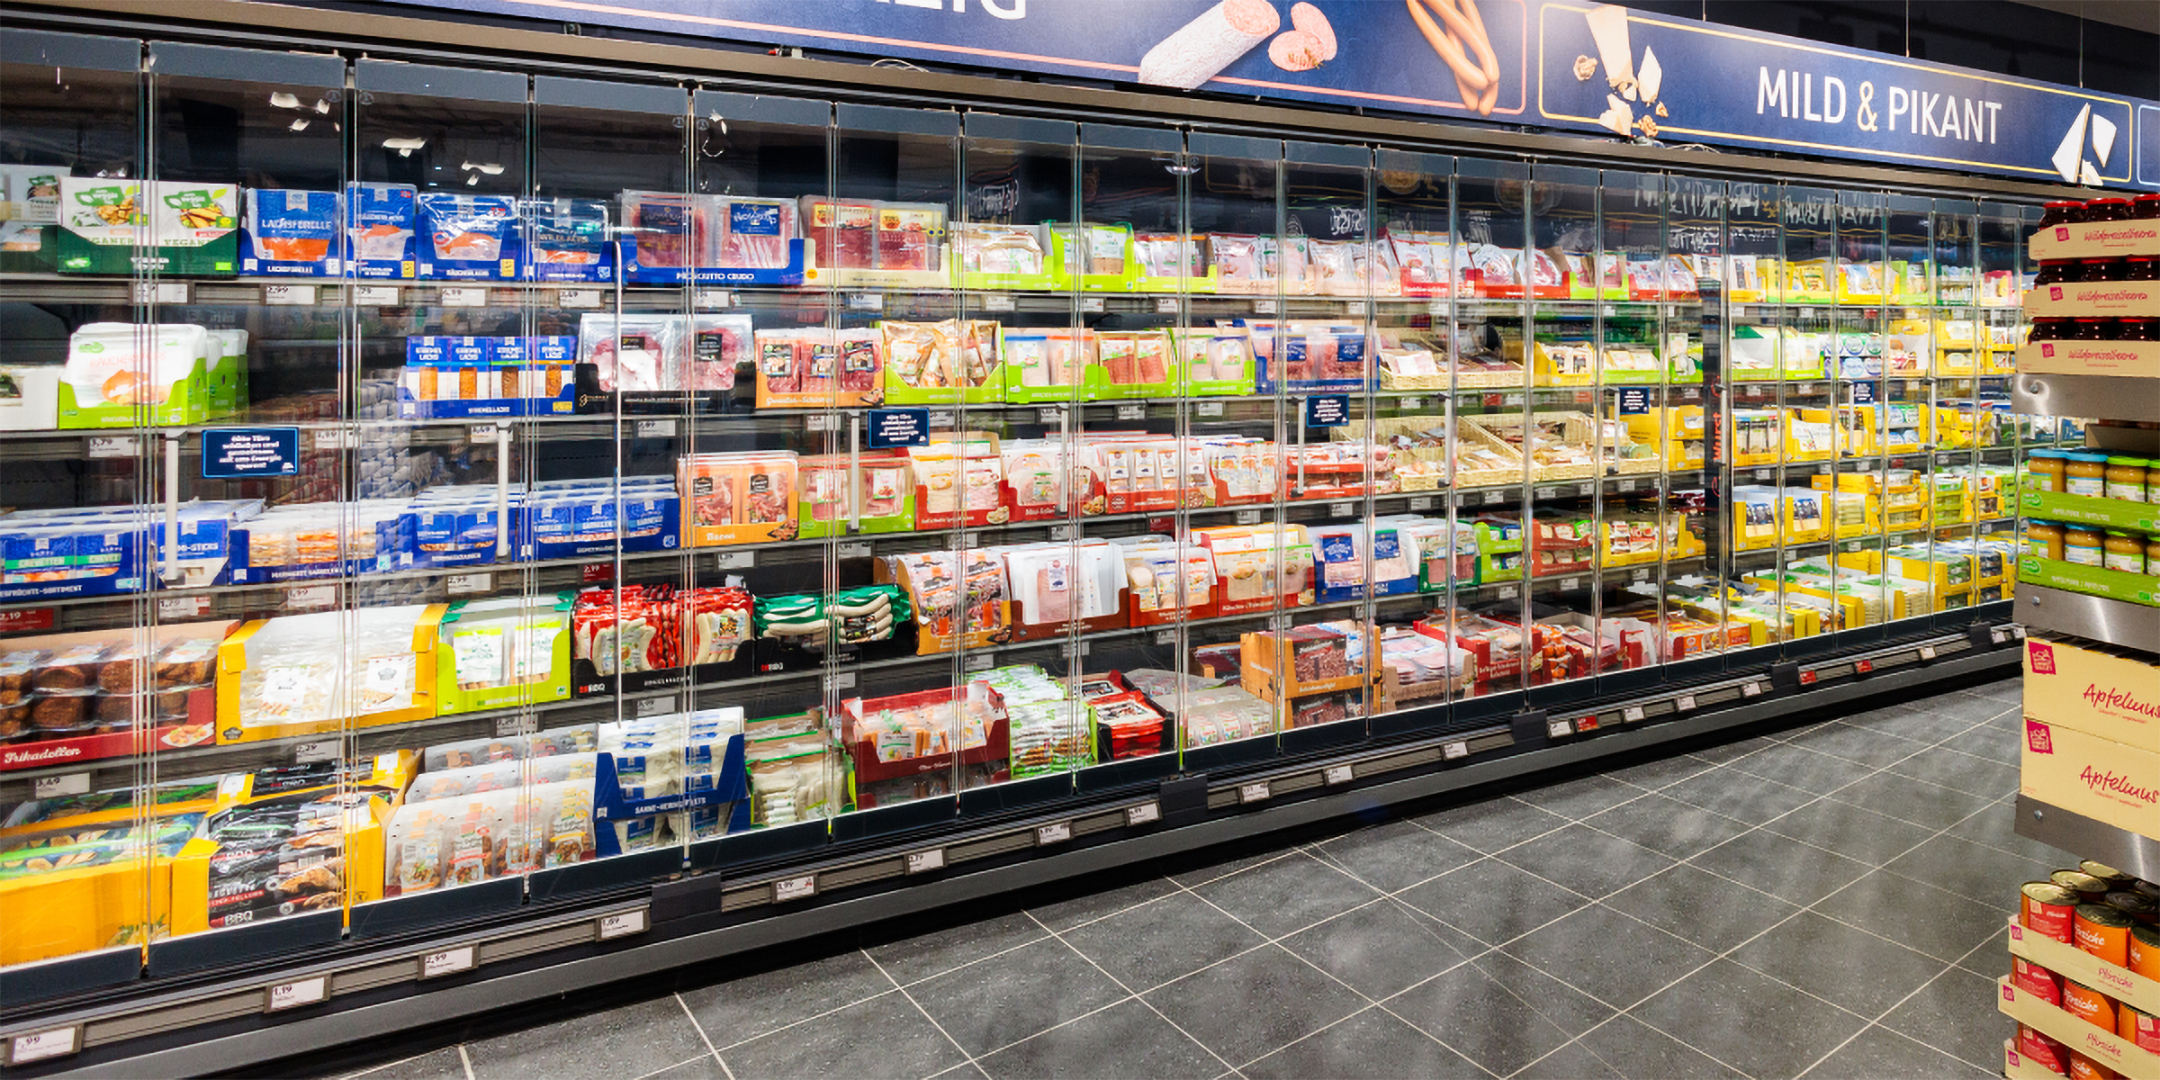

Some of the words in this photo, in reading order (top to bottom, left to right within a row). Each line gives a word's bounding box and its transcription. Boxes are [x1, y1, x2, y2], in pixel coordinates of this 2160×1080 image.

[1757, 66, 1846, 124] MILD
[1857, 80, 1878, 133] &
[1888, 86, 2002, 145] PIKANT
[4, 746, 82, 765] Frikadellen
[2080, 764, 2160, 804] Apfelmus
[225, 911, 253, 926] BBQ
